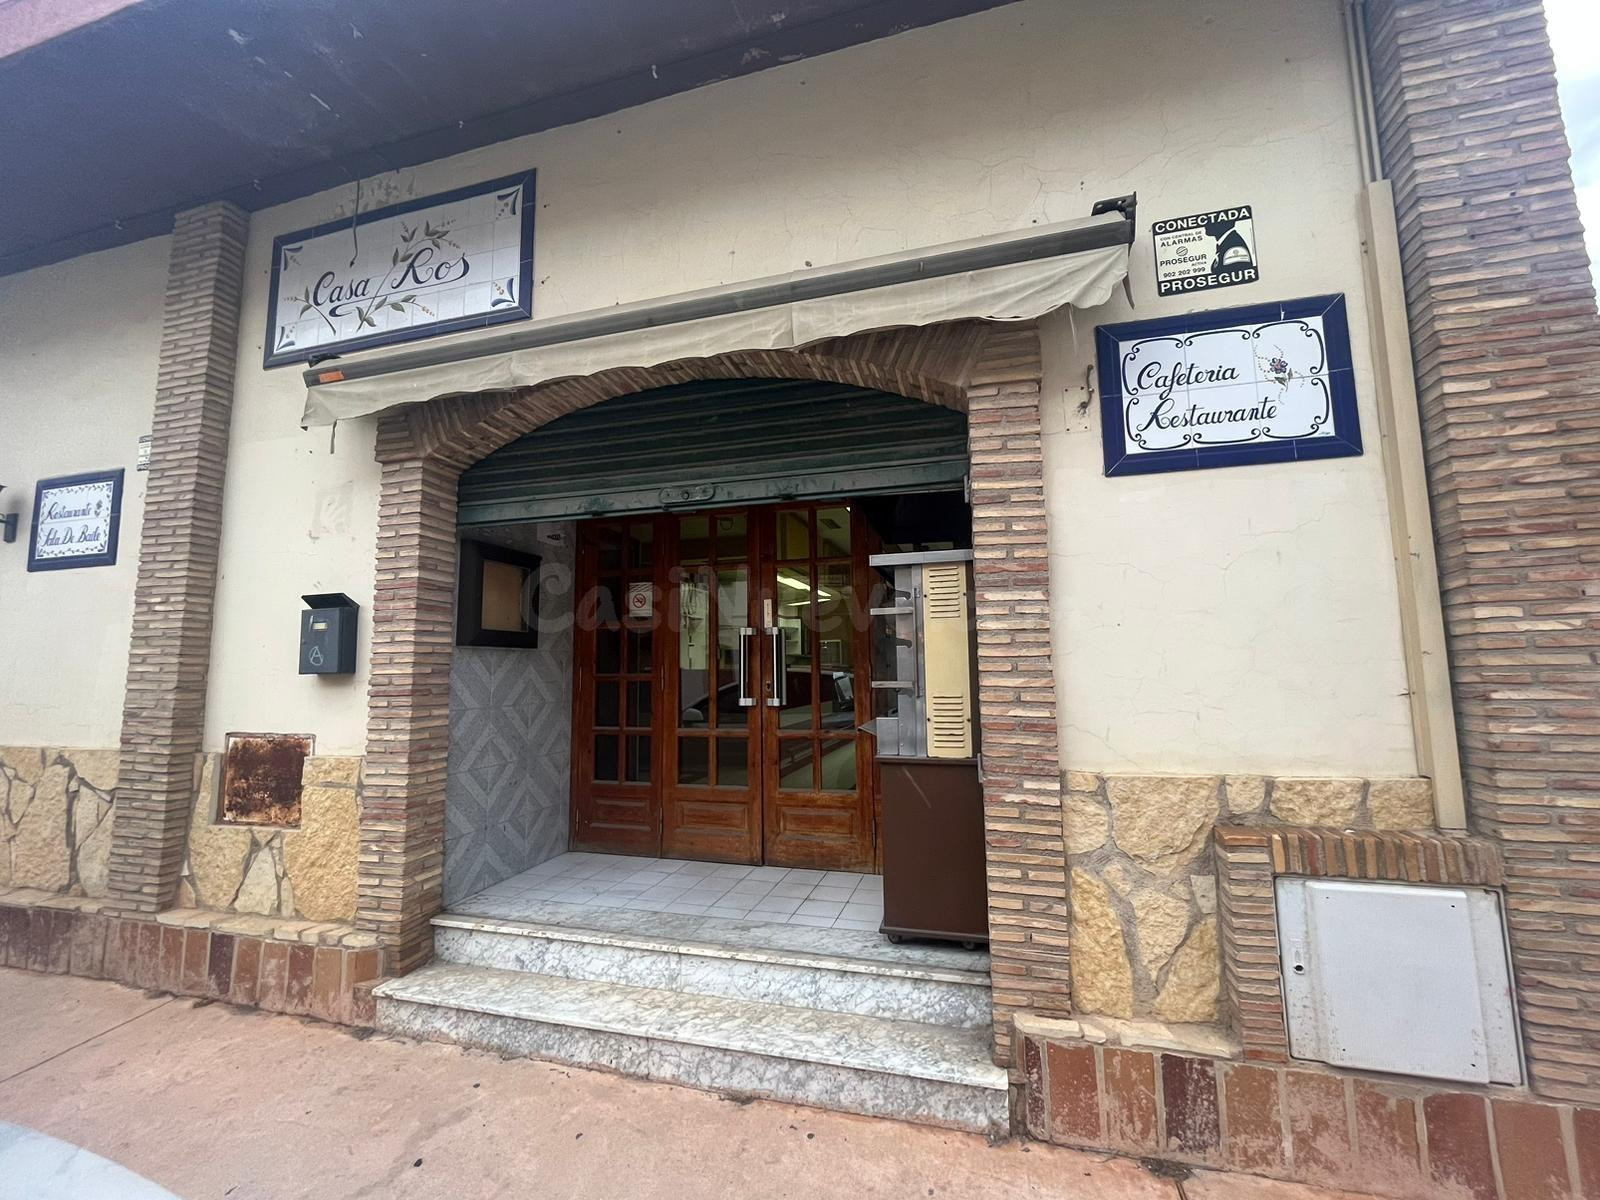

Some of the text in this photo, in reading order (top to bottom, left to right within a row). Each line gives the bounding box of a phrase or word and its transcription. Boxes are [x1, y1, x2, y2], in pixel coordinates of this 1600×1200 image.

[1155, 208, 1250, 233] CONECTADA
[1160, 236, 1203, 247] ALARMAS
[1160, 254, 1207, 266] PROSEGUR
[312, 247, 470, 307] Casa Ros
[1161, 269, 1256, 293] PROSEGUR
[1137, 361, 1240, 401] Cafeteria
[1136, 396, 1278, 433] Restaurante
